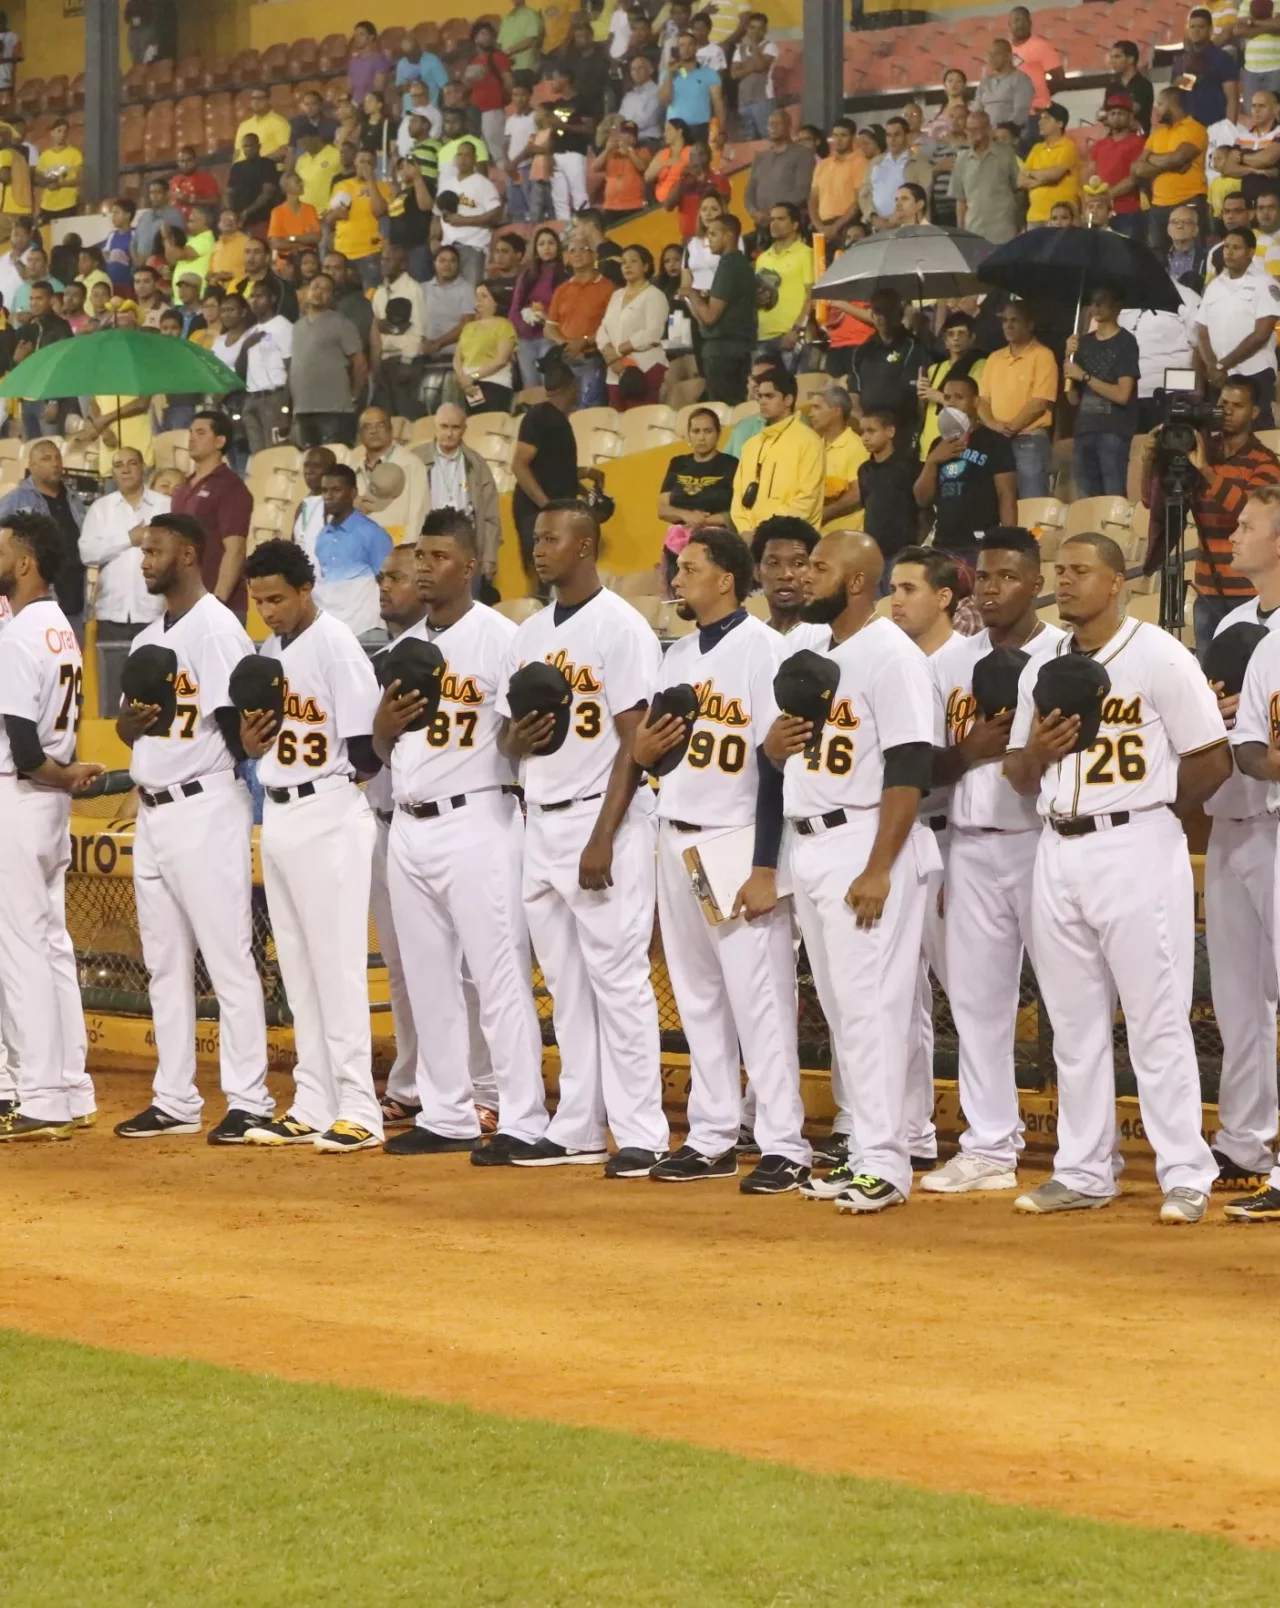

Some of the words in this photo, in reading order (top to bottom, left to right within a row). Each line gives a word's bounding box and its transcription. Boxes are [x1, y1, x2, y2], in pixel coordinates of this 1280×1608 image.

[426, 710, 480, 749] 87
[574, 700, 602, 740] 3
[276, 729, 328, 768] 63
[687, 731, 747, 774] 90
[802, 731, 854, 777] 46
[1085, 733, 1147, 785] 26
